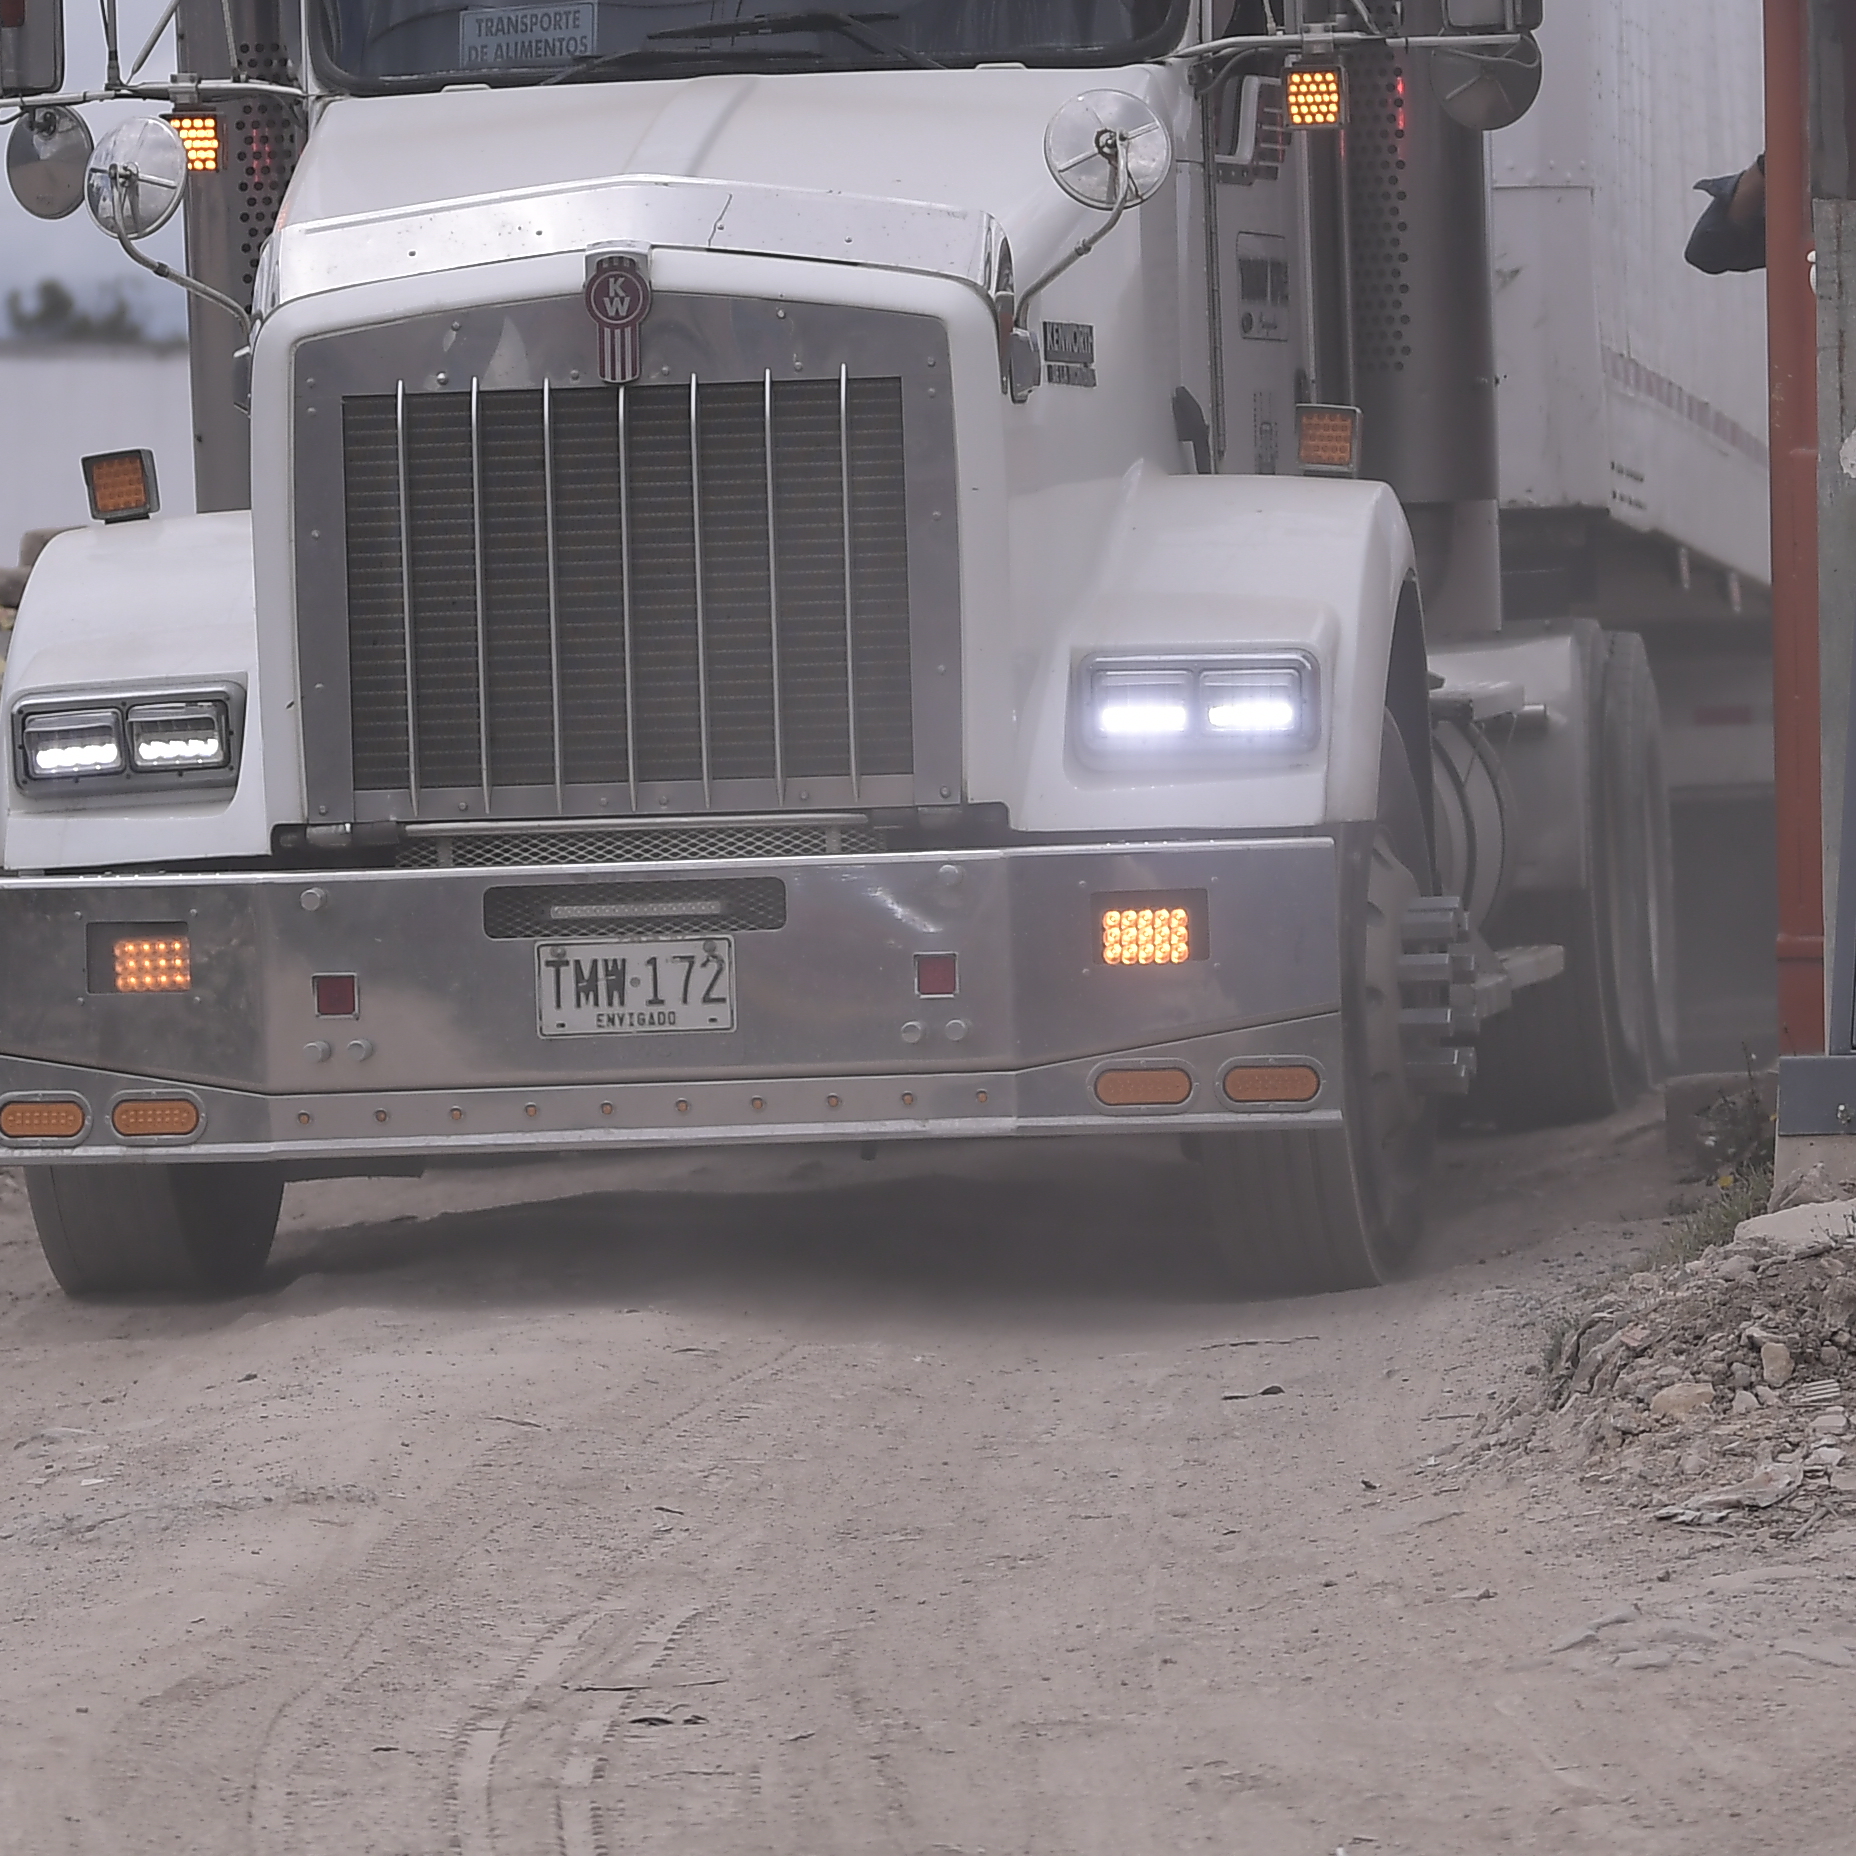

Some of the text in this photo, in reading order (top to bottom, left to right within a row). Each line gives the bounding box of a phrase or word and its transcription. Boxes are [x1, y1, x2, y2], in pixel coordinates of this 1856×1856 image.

[475, 9, 581, 37] TRANSPORTE
[468, 35, 588, 62] DE ALIMENTOS
[596, 1011, 676, 1028] ENVIGADO
